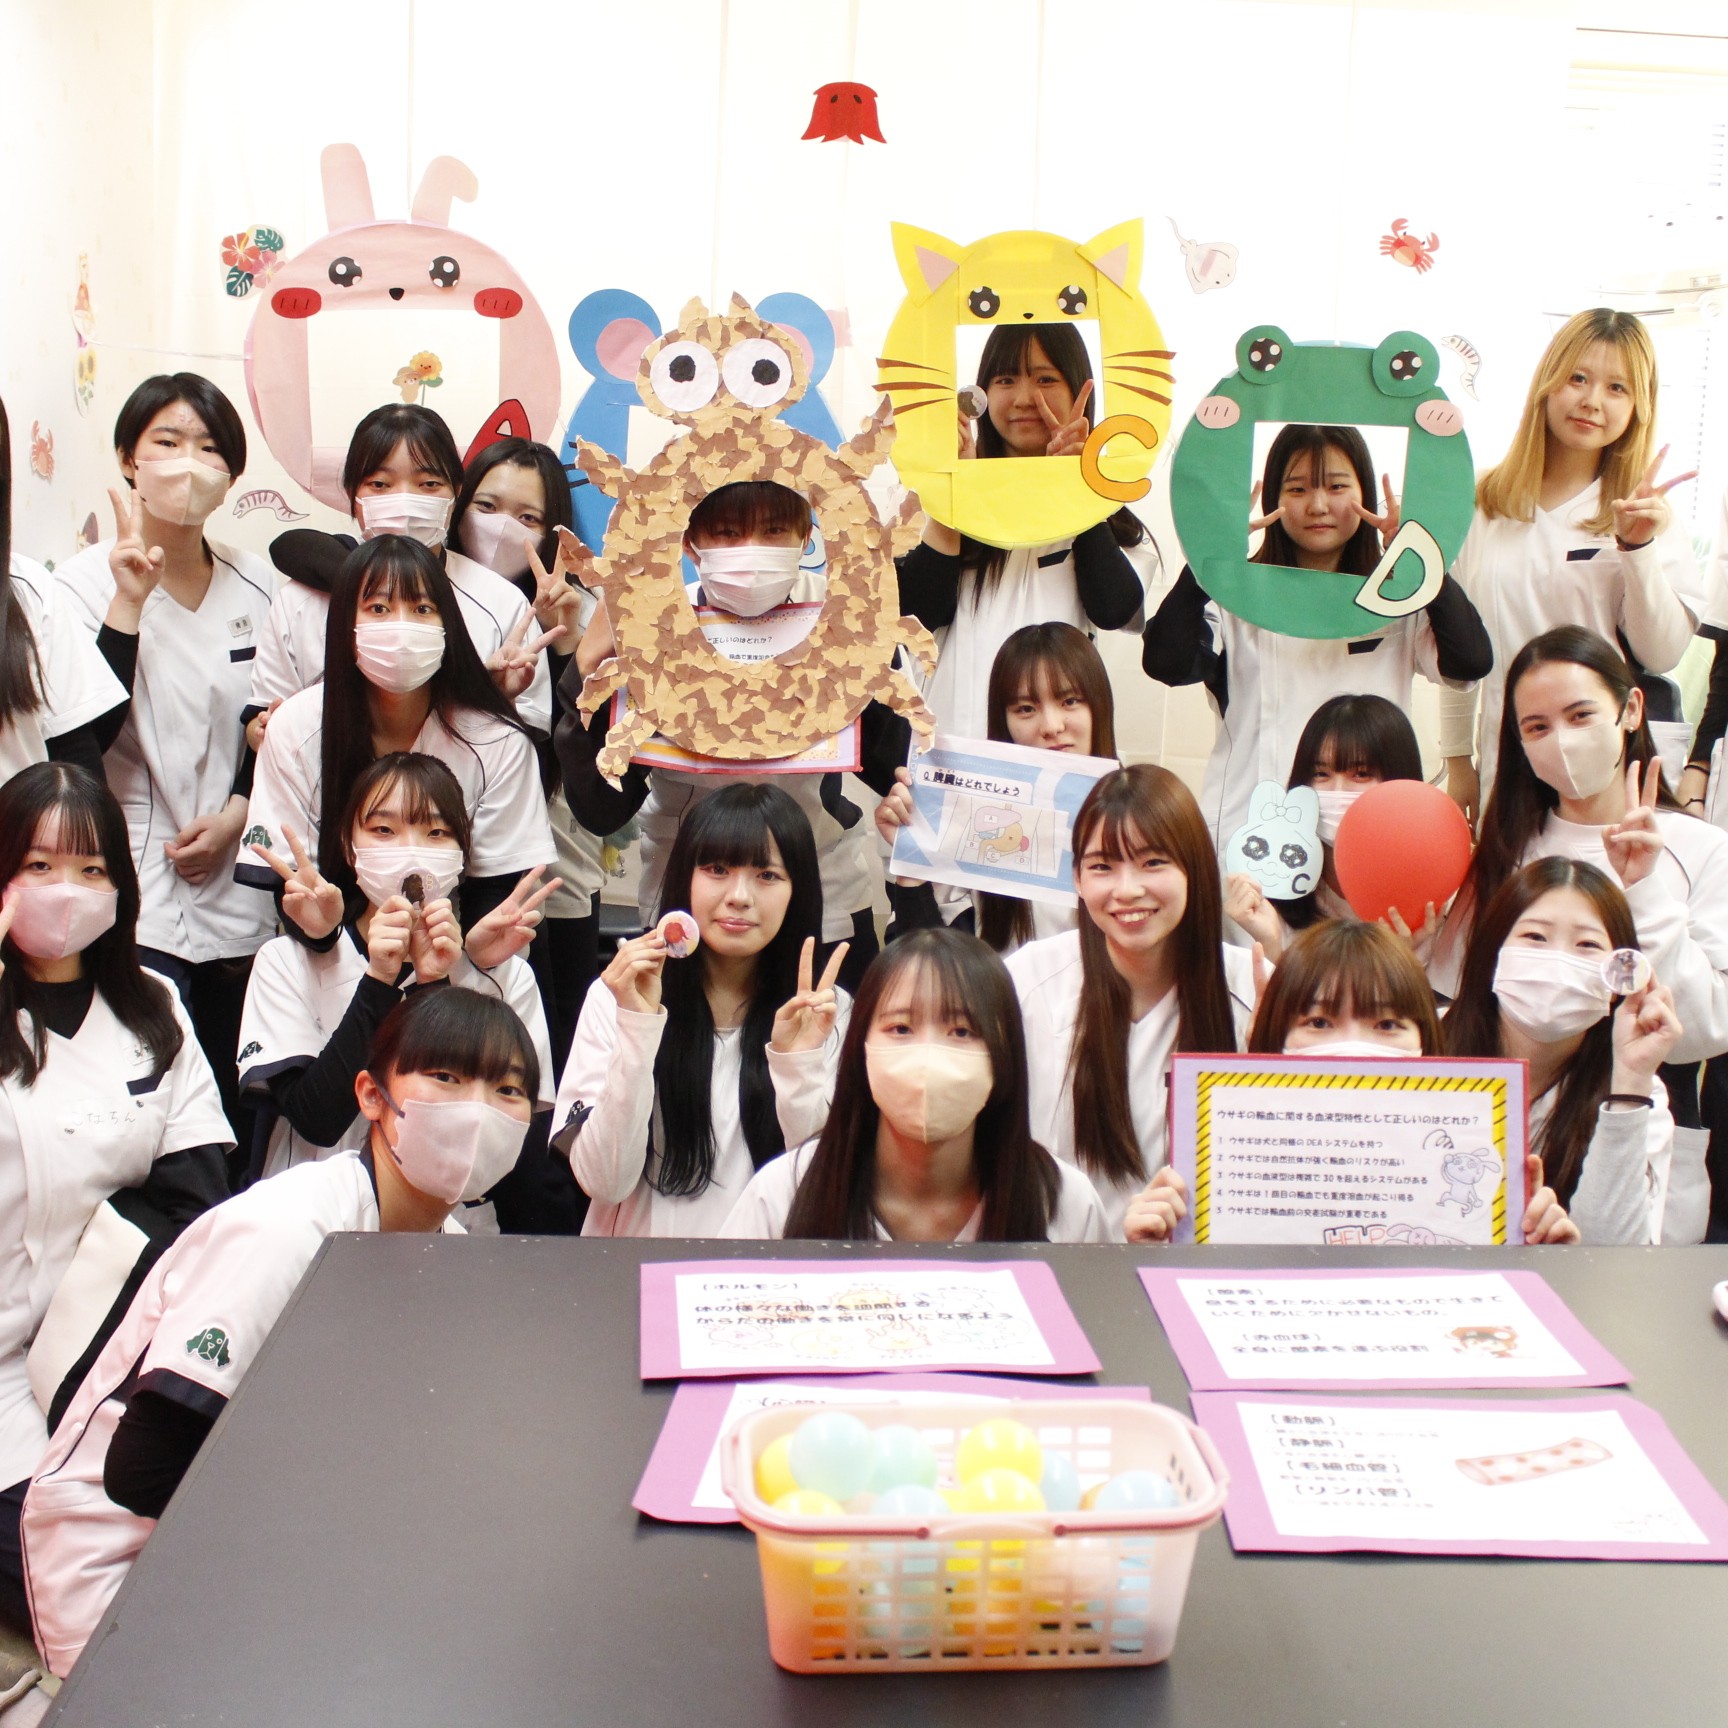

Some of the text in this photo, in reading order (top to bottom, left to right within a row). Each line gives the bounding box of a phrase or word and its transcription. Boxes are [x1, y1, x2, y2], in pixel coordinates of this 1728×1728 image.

[1080, 414, 1158, 502] C
[1355, 519, 1446, 617] D
[1291, 873, 1311, 894] C
[1326, 1140, 1383, 1148] システムを持つ
[1323, 1174, 1334, 1182] 30
